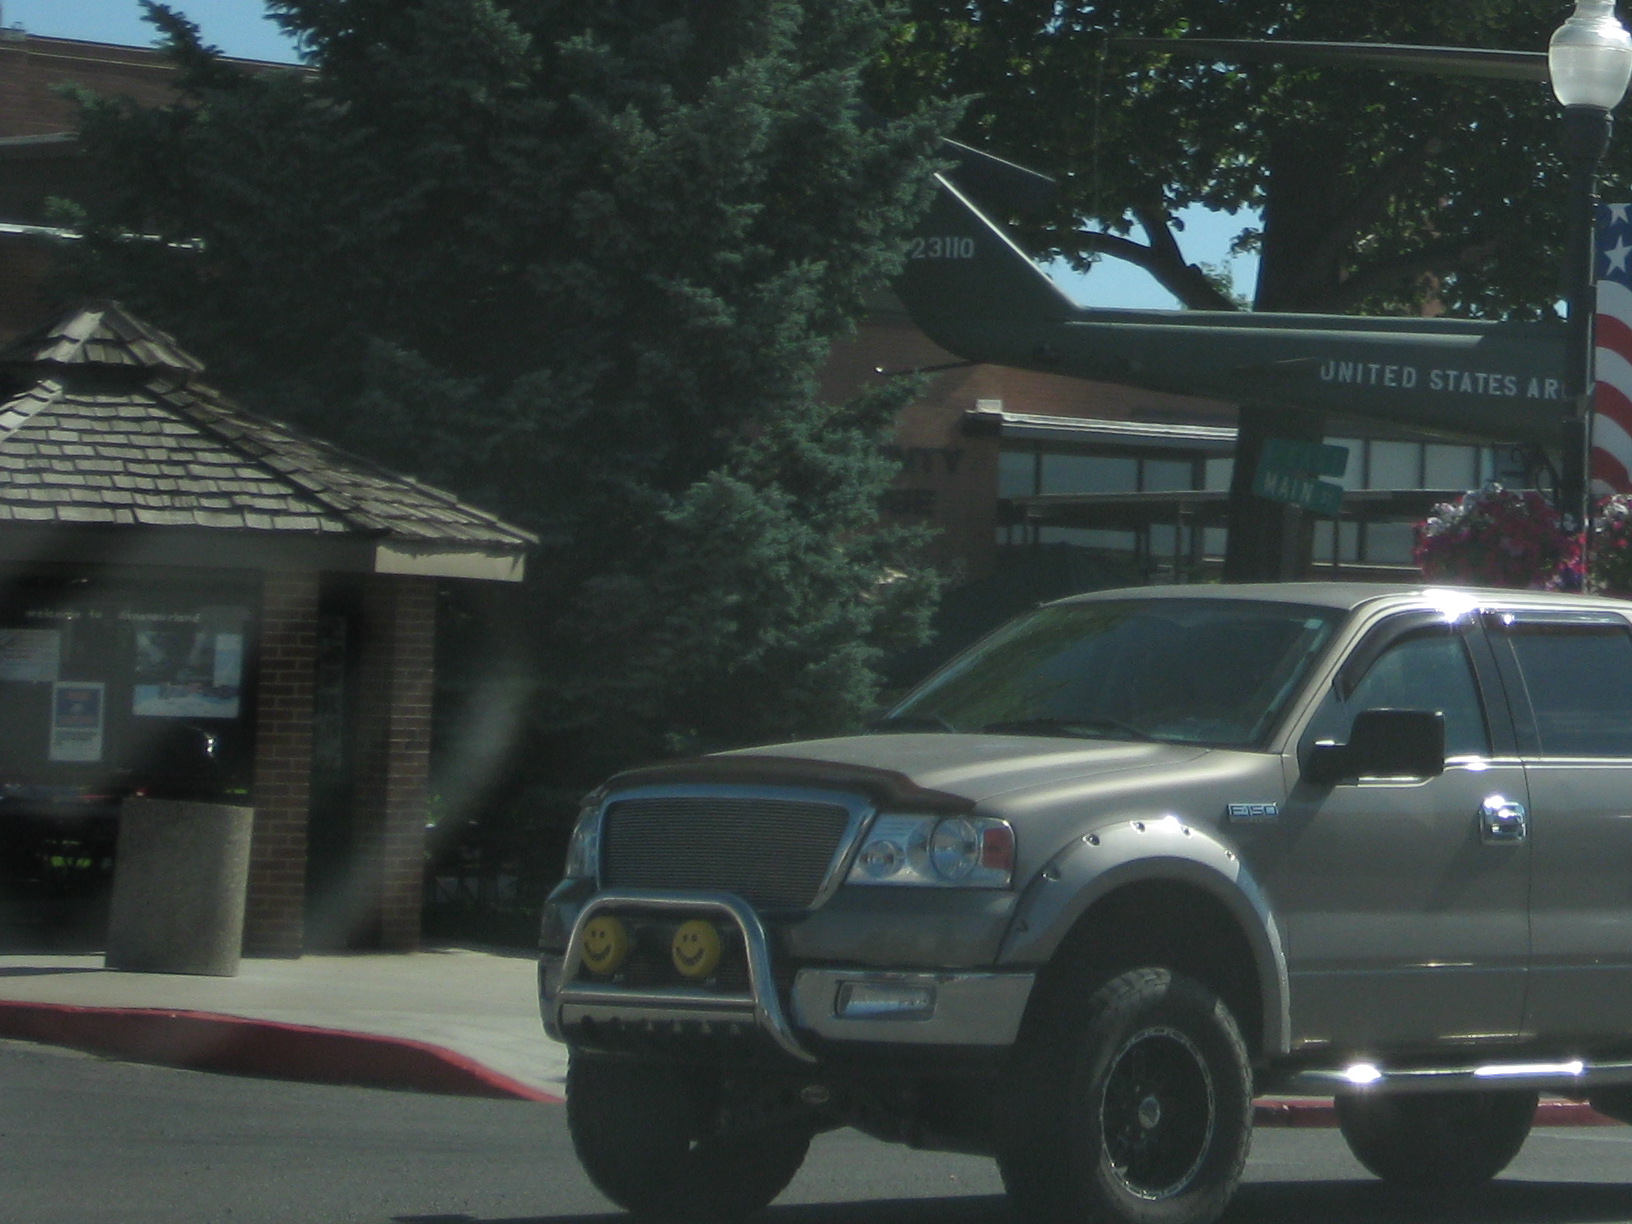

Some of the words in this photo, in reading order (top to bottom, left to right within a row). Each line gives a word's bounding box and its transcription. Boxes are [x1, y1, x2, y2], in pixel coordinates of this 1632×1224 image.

[910, 235, 976, 260] 23110
[1320, 360, 1418, 389] UNITED
[1430, 369, 1518, 397] STATES
[1527, 376, 1567, 400] AR
[1263, 471, 1314, 505] MAIN
